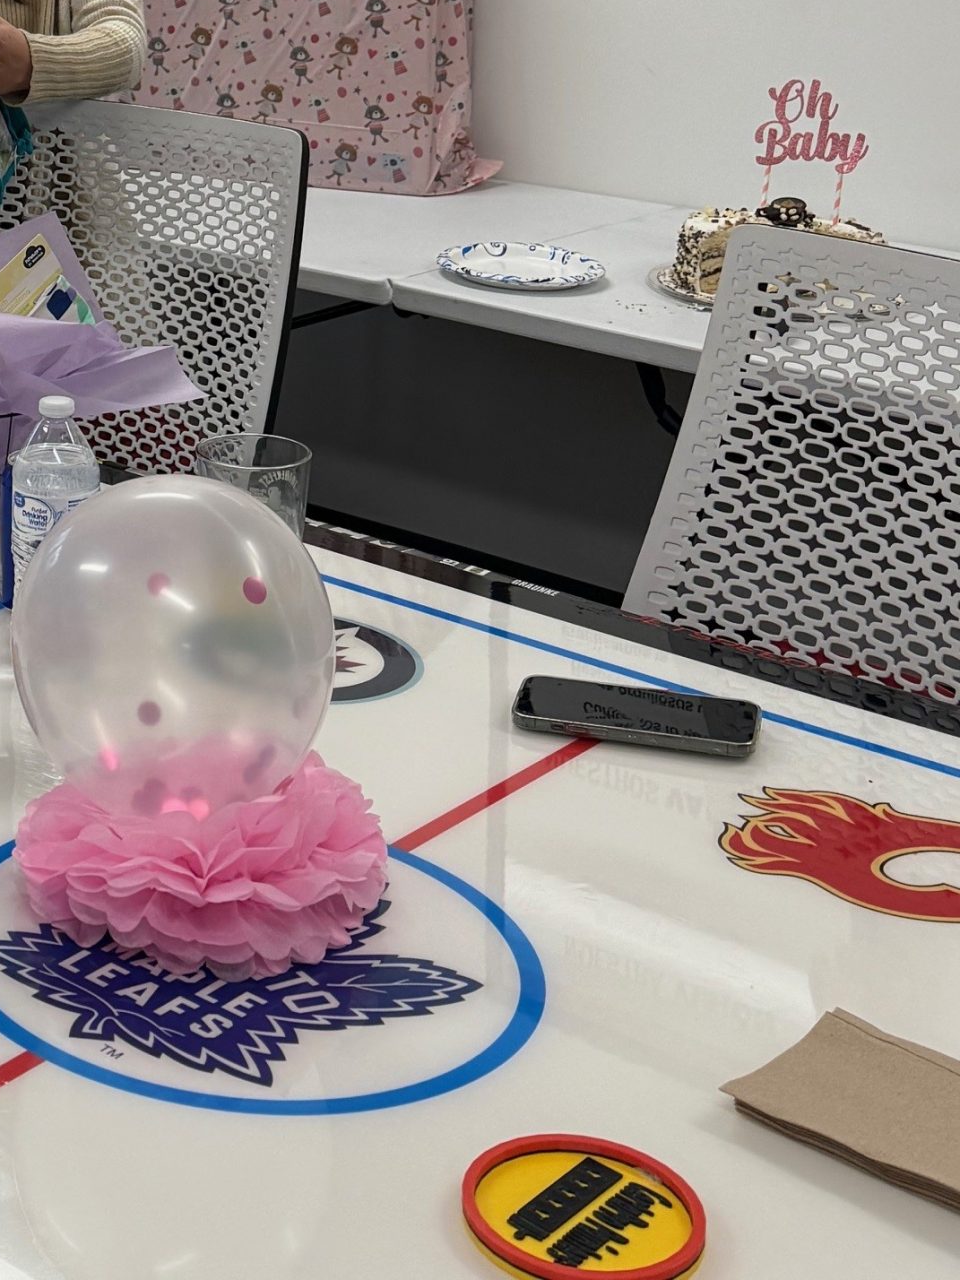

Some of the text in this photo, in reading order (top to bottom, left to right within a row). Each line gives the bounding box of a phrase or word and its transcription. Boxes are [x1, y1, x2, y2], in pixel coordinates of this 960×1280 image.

[768, 79, 838, 123] Oh
[755, 121, 869, 174] Baby
[57, 949, 234, 1039] LEAFS
